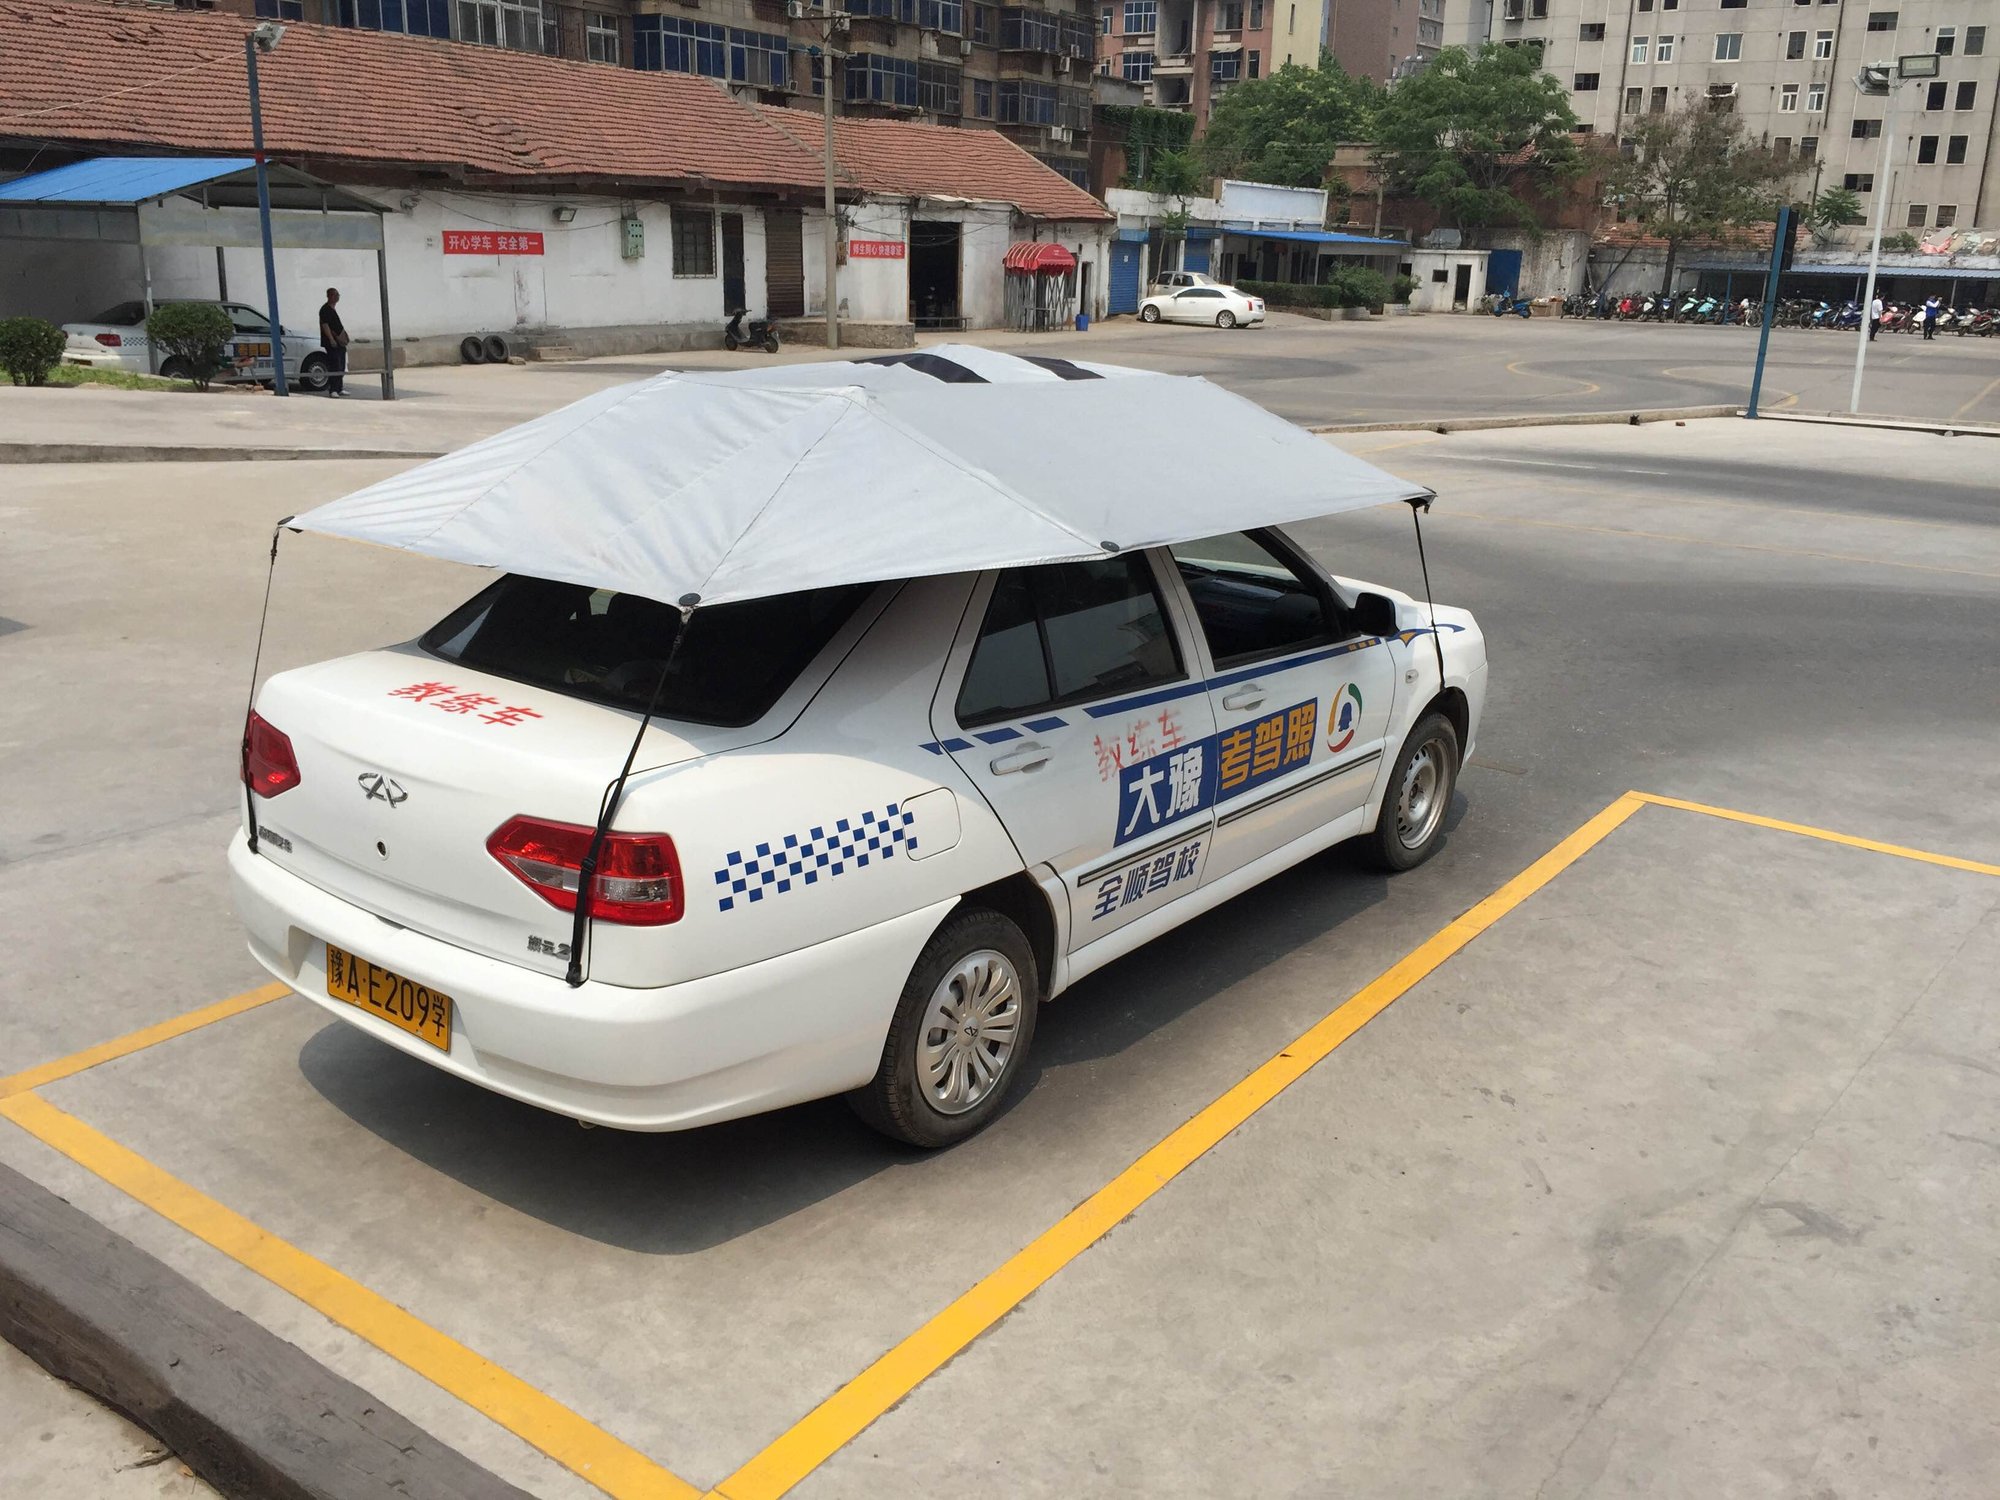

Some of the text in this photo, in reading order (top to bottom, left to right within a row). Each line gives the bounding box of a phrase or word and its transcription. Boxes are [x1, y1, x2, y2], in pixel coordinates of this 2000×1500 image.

[448, 235, 493, 250] 开心学车
[497, 236, 538, 251] 安全第一
[853, 243, 877, 256] 师生同心
[387, 682, 544, 726] 教练车
[1094, 708, 1187, 782] 教练车
[1220, 702, 1315, 790] 考驾照
[1091, 840, 1201, 922] 全顺驾校
